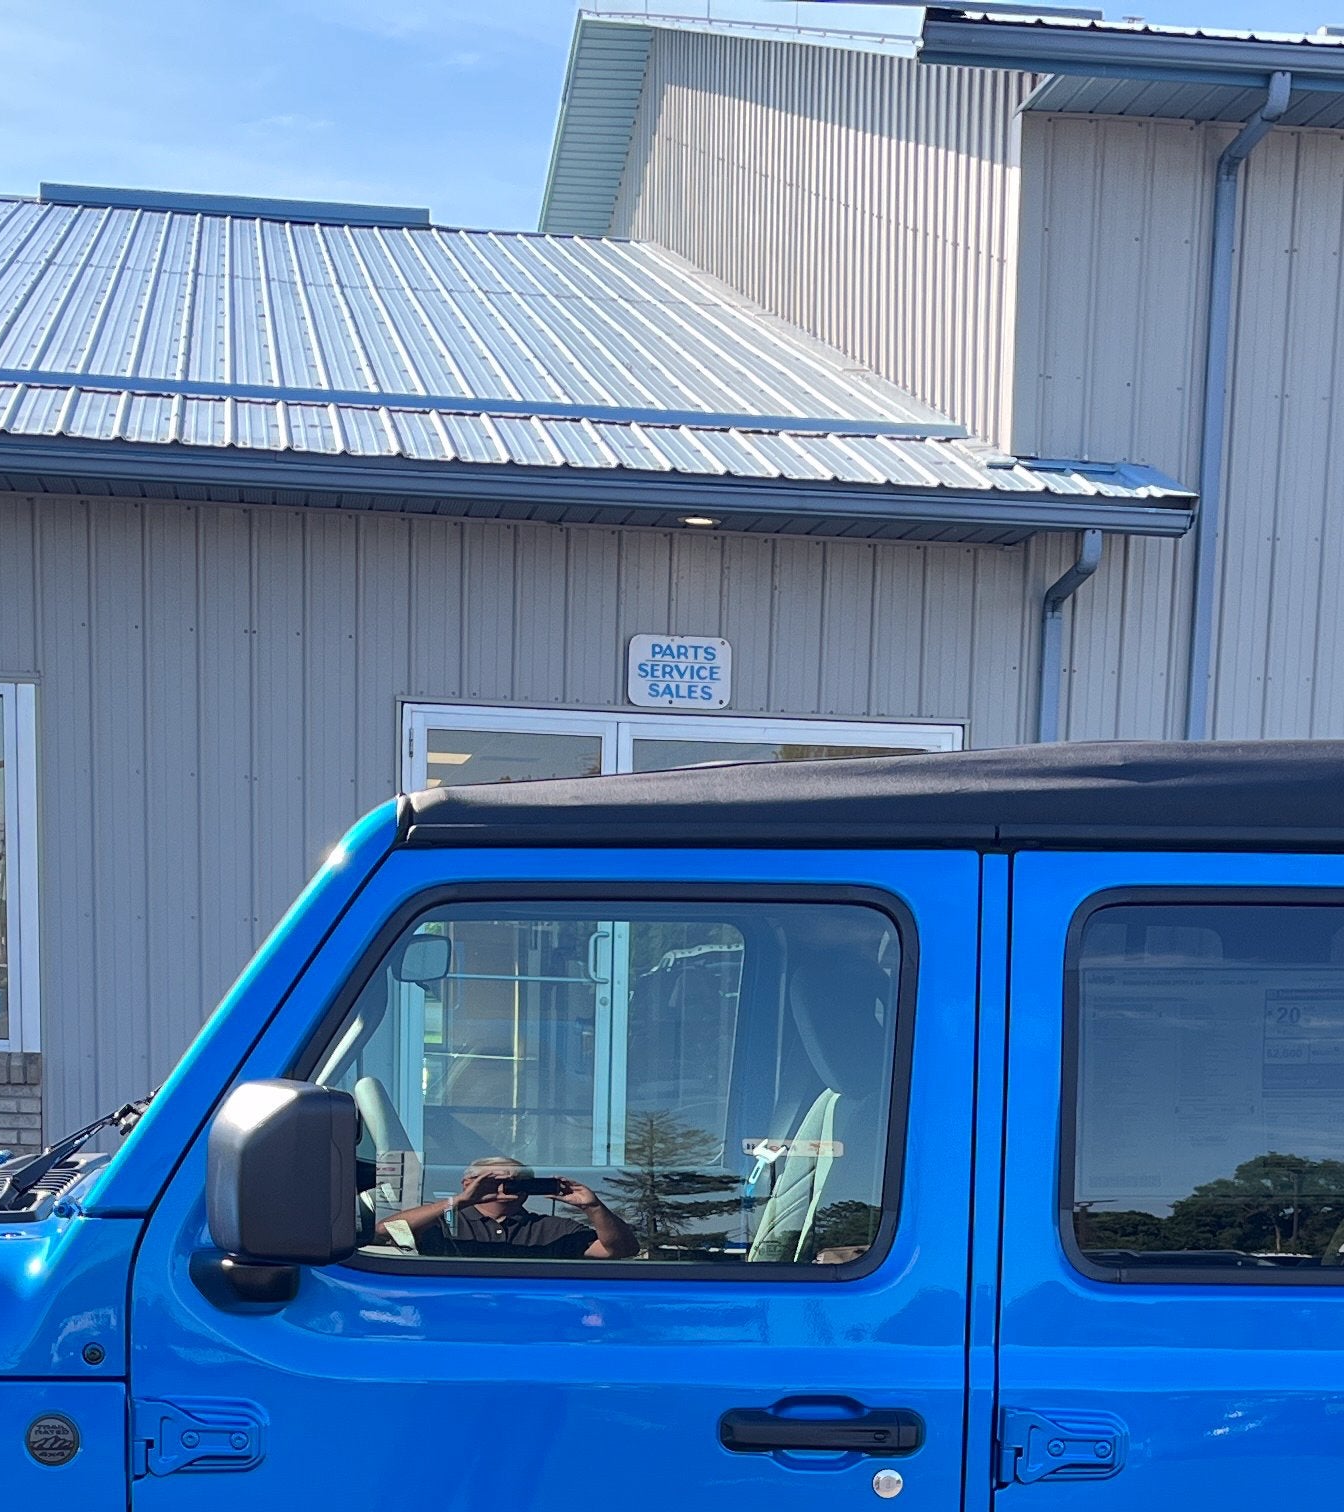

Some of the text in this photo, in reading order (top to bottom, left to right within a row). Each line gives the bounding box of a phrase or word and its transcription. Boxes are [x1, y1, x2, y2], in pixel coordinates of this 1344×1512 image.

[651, 643, 717, 661] PARTS
[637, 663, 721, 681] SERVICE
[648, 683, 713, 701] SALES
